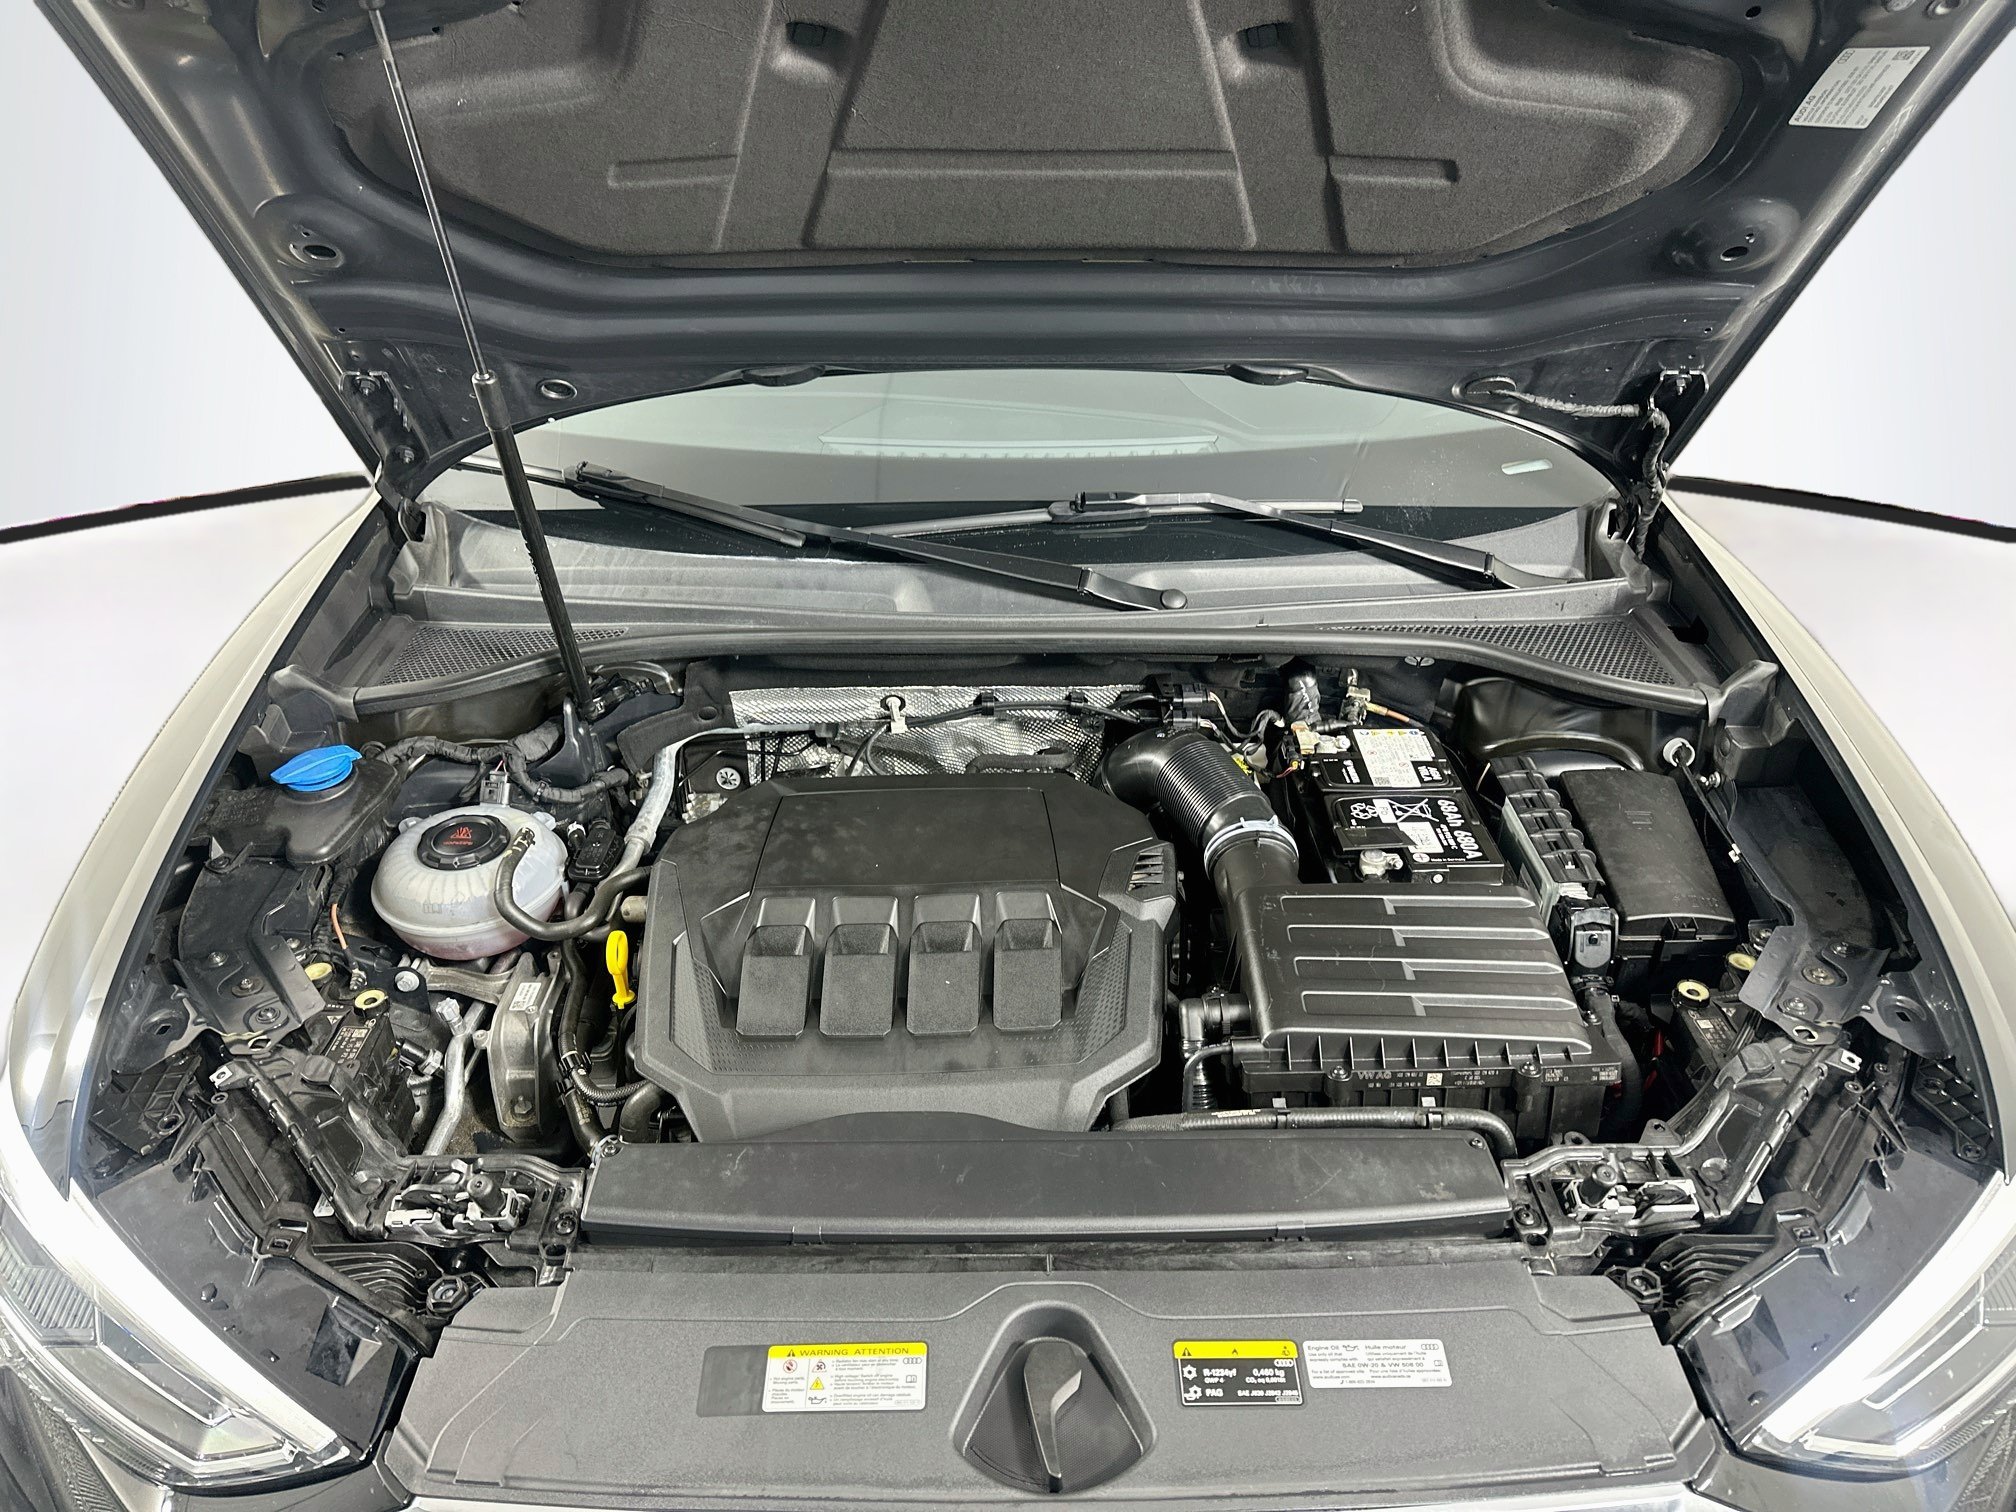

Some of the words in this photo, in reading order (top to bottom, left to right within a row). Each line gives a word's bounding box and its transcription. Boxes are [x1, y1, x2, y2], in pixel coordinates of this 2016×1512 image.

[1794, 106, 1809, 122] AUDI
[1437, 799, 1465, 827] 68Ah
[1453, 830, 1483, 859] 680A
[800, 1349, 848, 1357] WARNING
[854, 1347, 909, 1356] ATTENTION
[1202, 1368, 1237, 1378] R-1234yf
[1275, 1368, 1286, 1378] kg
[1205, 1388, 1224, 1397] PAG
